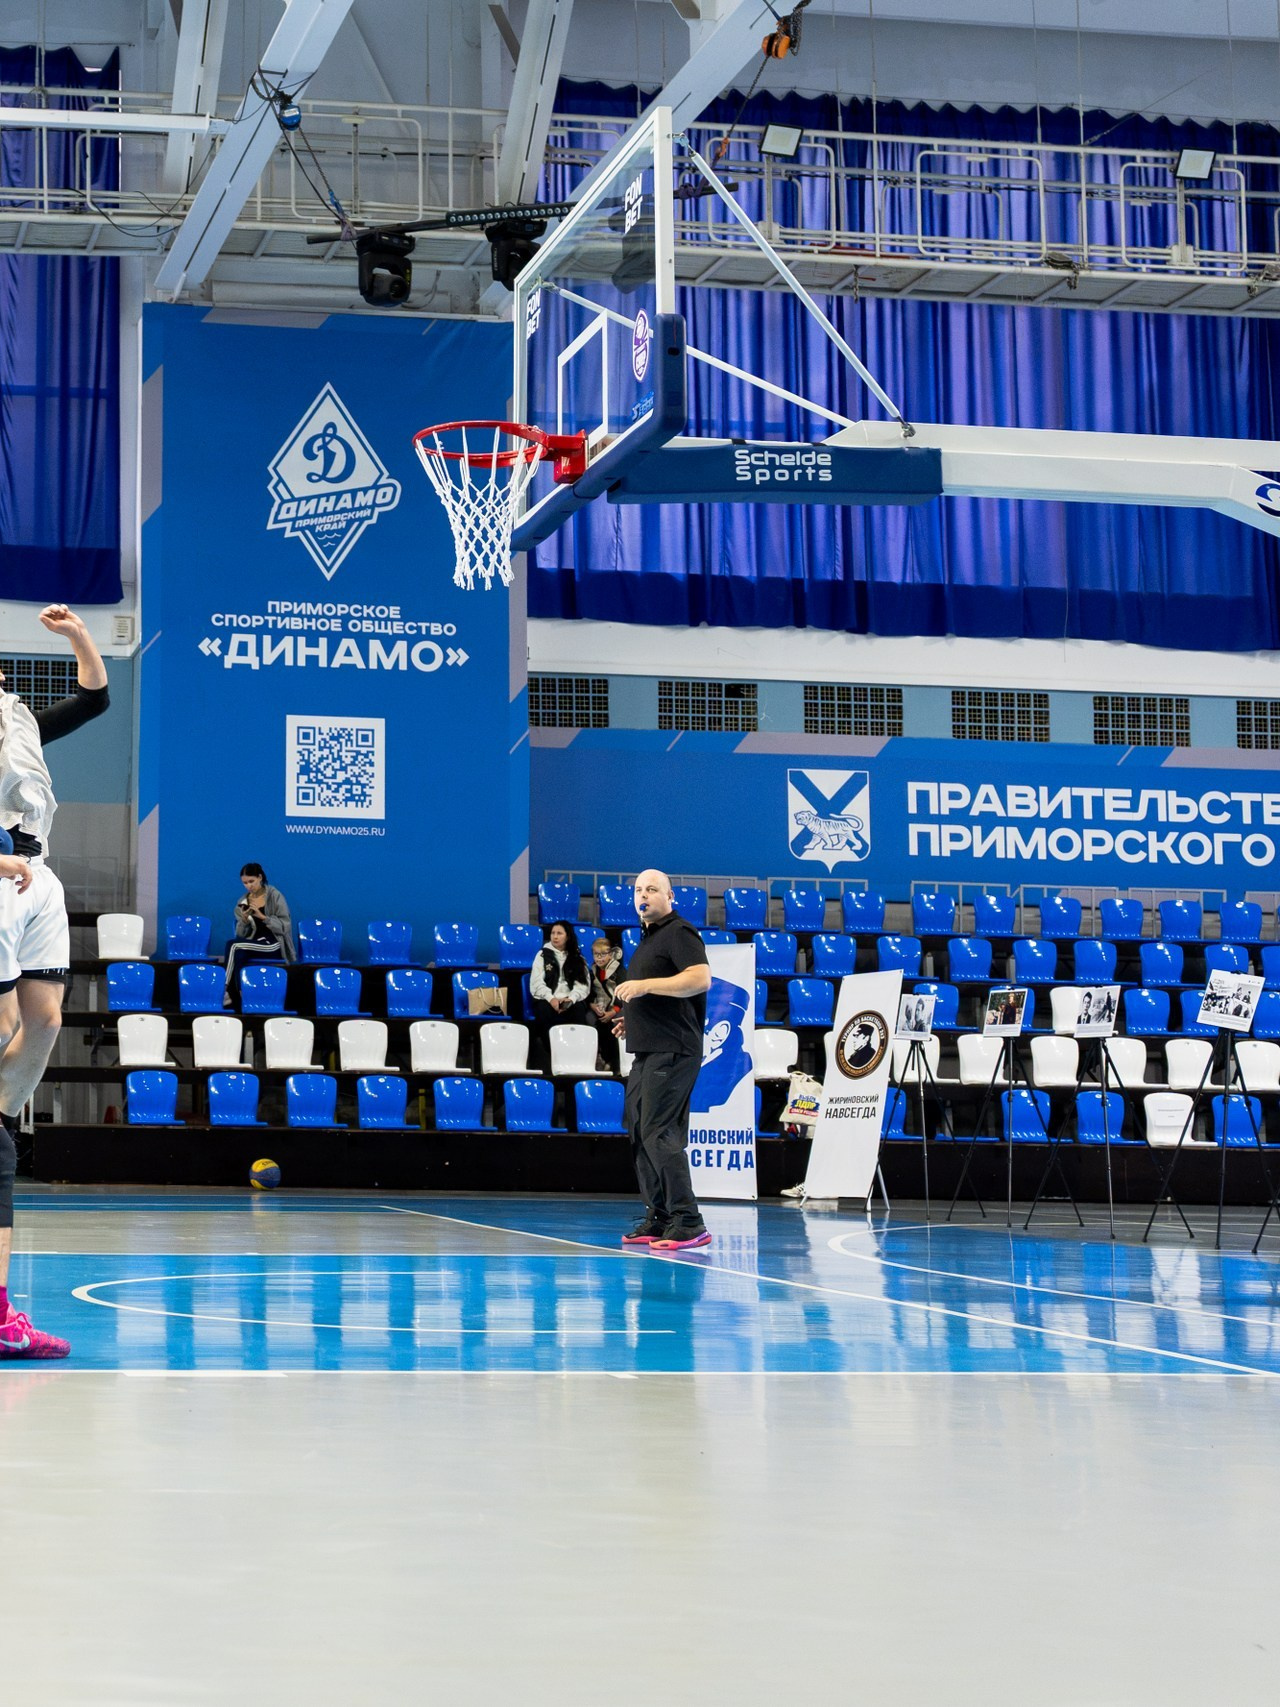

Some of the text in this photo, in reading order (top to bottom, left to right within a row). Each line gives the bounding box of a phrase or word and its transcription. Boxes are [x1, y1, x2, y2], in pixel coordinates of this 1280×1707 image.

[625, 173, 643, 212] FON
[625, 197, 643, 234] BET
[526, 288, 541, 321] FON
[526, 308, 541, 340] BET
[734, 449, 832, 466] Schelde
[735, 465, 833, 485] Sports
[277, 486, 394, 520] ДИНАМО
[295, 508, 372, 528] ПРИМОРСКИЙ
[315, 519, 347, 533] КРАЙ
[267, 600, 401, 619] ПРИМОРСКОЕ
[211, 613, 457, 637] СПОРТИВНОЕ ОБЩЕСТВО
[198, 633, 470, 673] «ДИНАМО»
[285, 824, 385, 836] WWW.DYNAMO25.RU
[908, 823, 1276, 867] ПРИМОРСКОГО
[827, 1094, 879, 1105] ЖИРИНОВСКИЙ
[825, 1106, 877, 1119] НАВСЕГДА
[689, 1127, 753, 1145] НОВСКИЙ
[690, 1149, 755, 1171] СЕГДА
